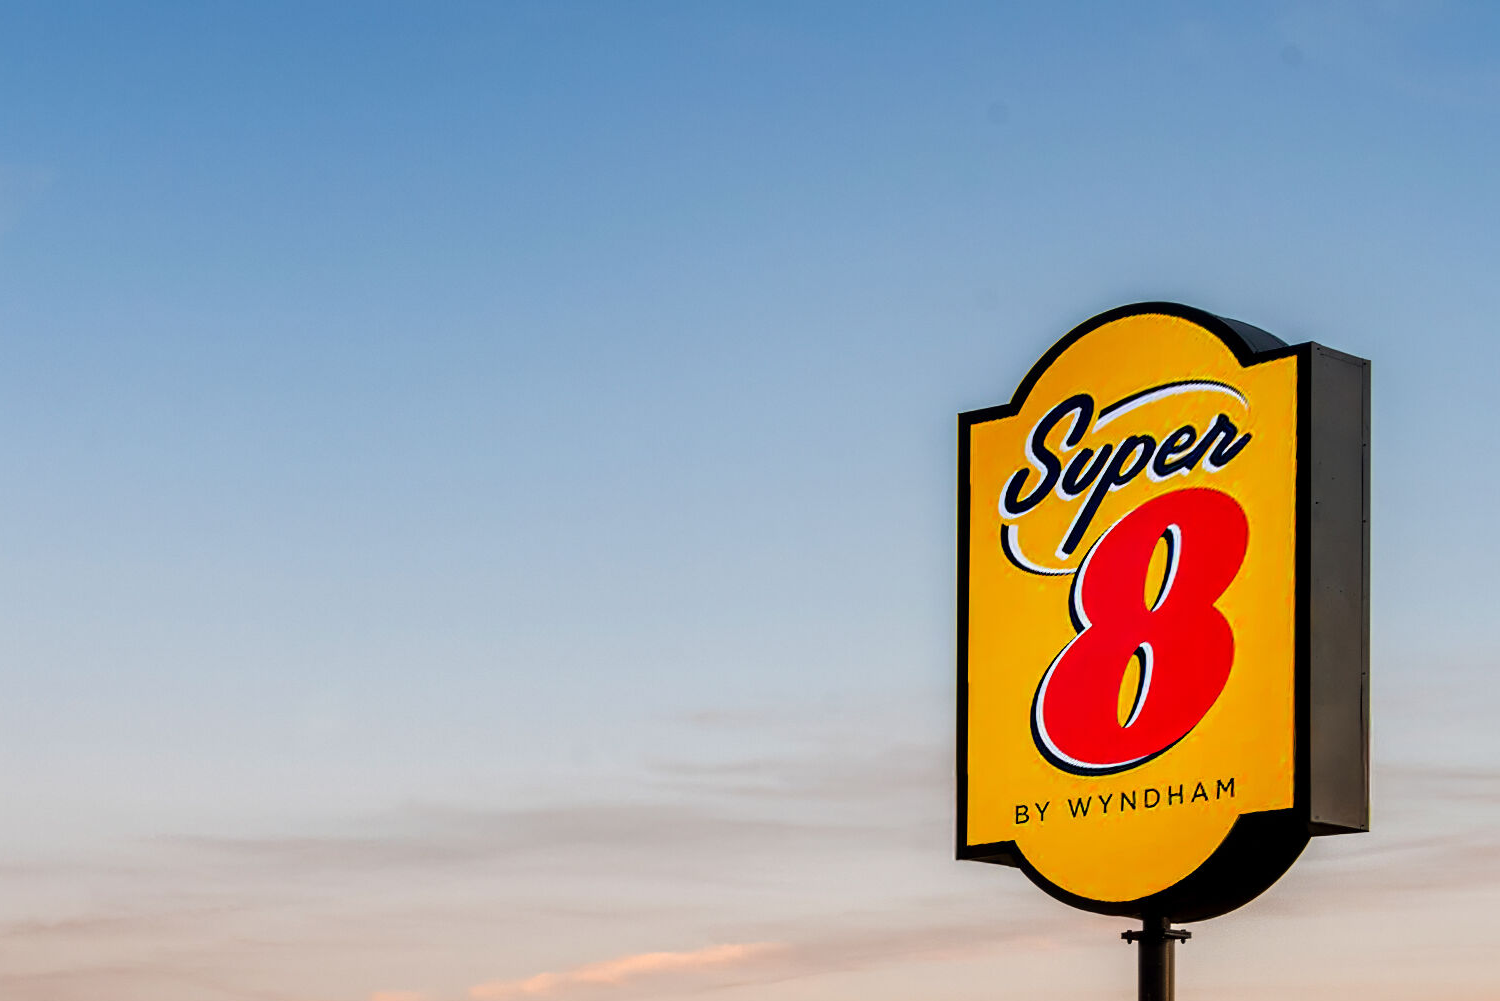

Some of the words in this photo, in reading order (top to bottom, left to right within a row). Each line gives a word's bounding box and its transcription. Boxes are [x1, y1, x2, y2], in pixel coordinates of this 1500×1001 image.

[1000, 393, 1253, 561] Super
[1030, 486, 1250, 778] 8
[1014, 801, 1051, 825] BY
[1067, 777, 1236, 819] WYNDHAM
